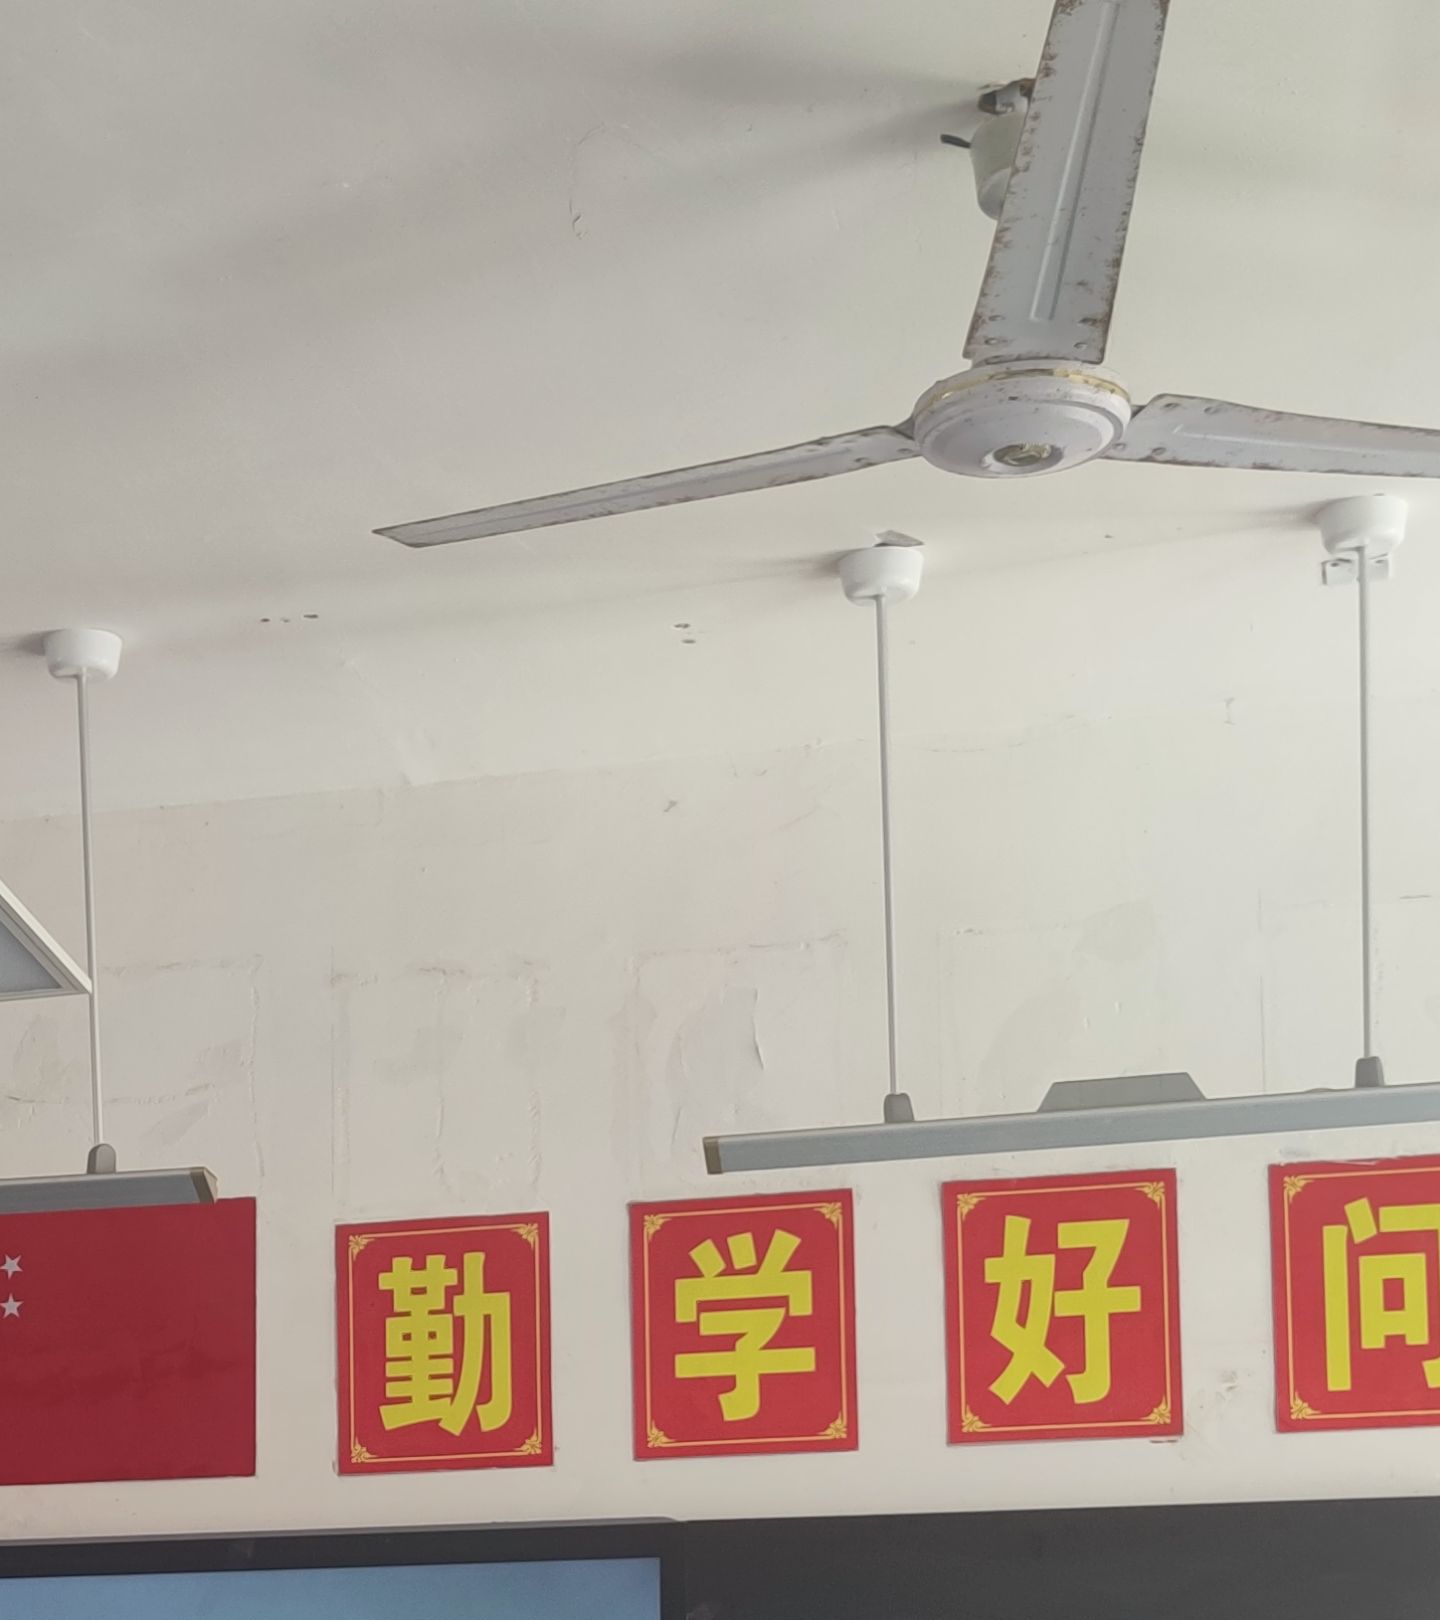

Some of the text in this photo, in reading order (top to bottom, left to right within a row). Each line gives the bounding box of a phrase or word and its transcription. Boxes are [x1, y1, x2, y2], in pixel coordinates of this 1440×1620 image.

[378, 1251, 512, 1435] 勤
[674, 1229, 814, 1421] 学
[984, 1214, 1140, 1405] 好
